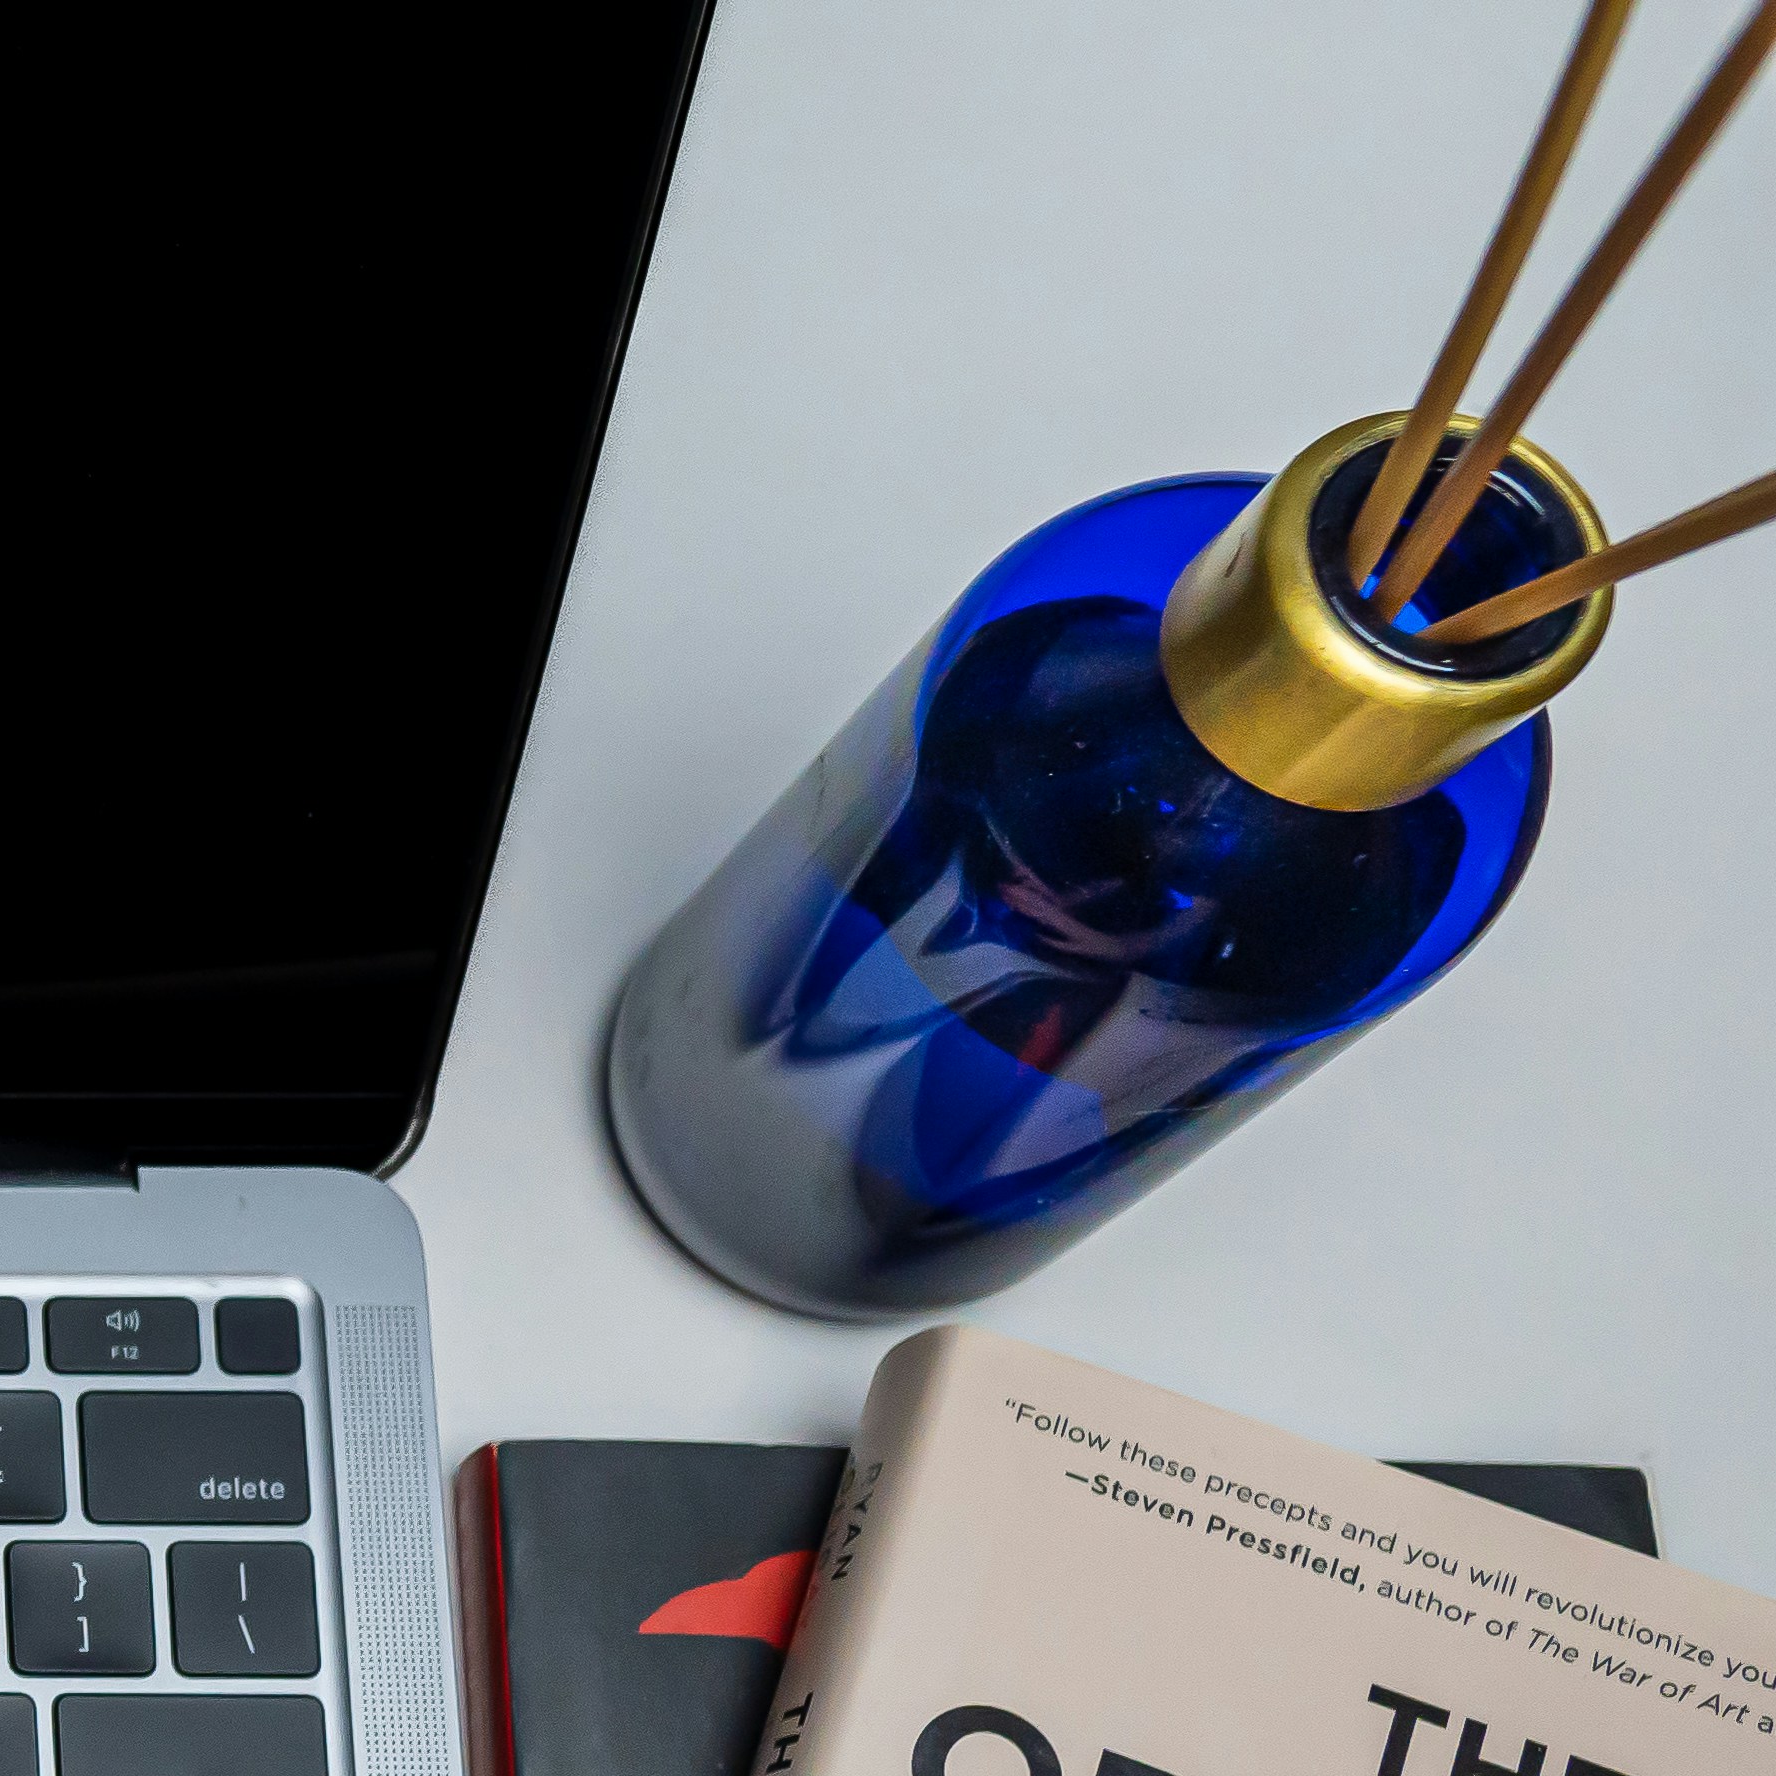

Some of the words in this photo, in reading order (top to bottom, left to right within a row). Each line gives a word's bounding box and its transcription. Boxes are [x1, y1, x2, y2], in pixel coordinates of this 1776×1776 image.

[111, 1345, 139, 1360] F12
[199, 1476, 285, 1500] delete
[1120, 1439, 1196, 1483] these
[1204, 1474, 1333, 1532] precepts
[1340, 1522, 1398, 1555] and
[1402, 1544, 1459, 1577] you
[1469, 1565, 1518, 1597] will
[1524, 1587, 1715, 1667] revolutionize
[71, 1561, 88, 1603] }
[76, 1616, 90, 1653] ]
[237, 1614, 256, 1654] \
[1205, 1513, 1365, 1593] Pressfield,
[1376, 1580, 1477, 1626] author
[1485, 1619, 1519, 1641] of
[1528, 1627, 1579, 1664] The
[1591, 1650, 1653, 1688] War
[1659, 1681, 1697, 1704] of
[1696, 1693, 1751, 1725] Art
